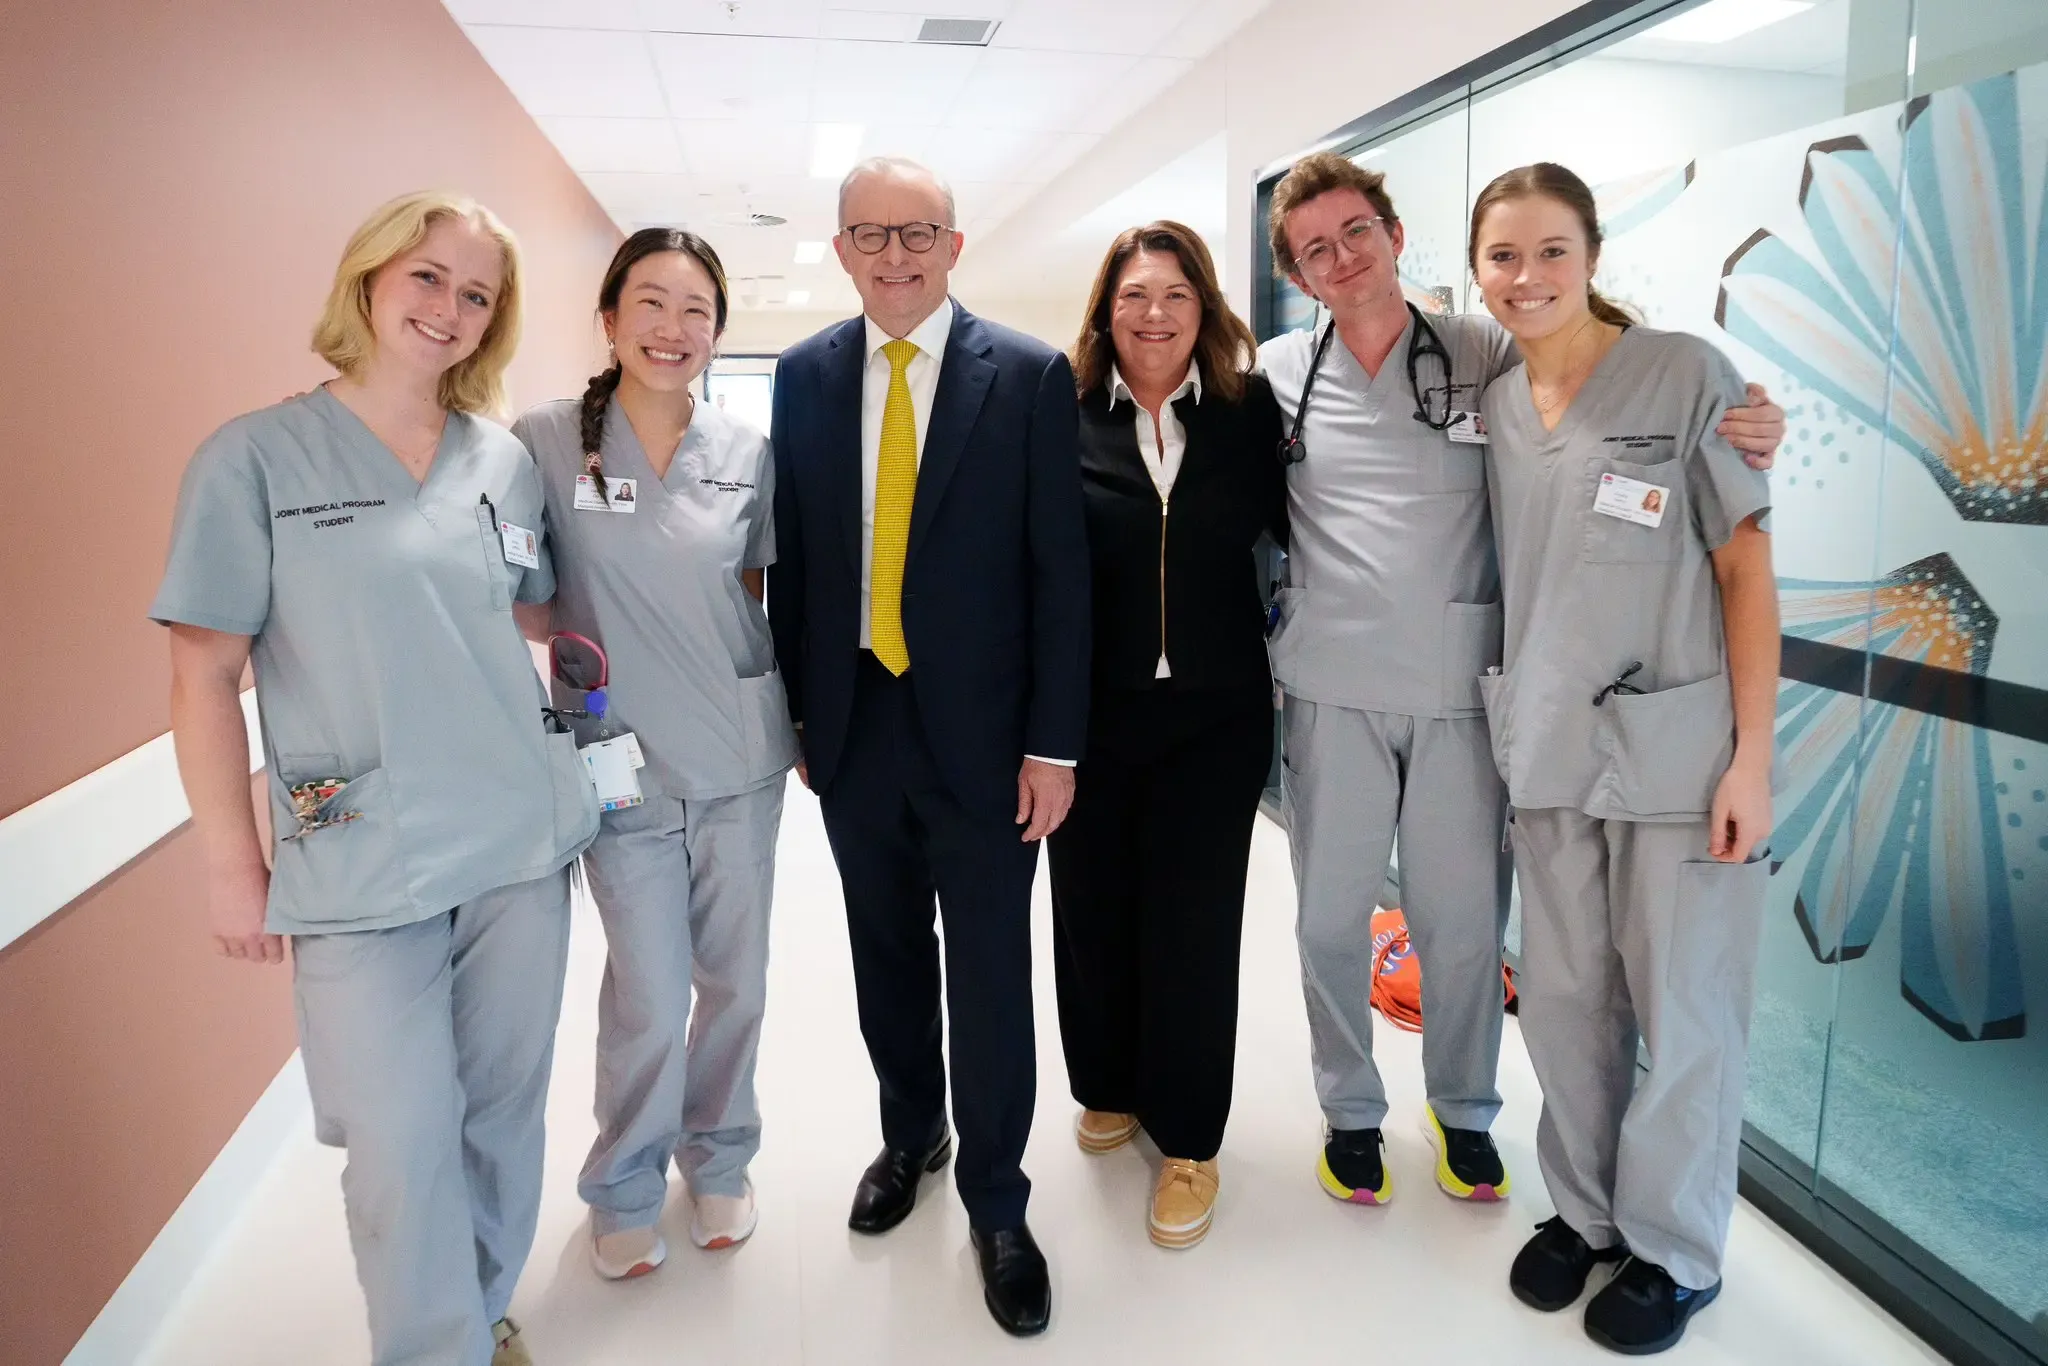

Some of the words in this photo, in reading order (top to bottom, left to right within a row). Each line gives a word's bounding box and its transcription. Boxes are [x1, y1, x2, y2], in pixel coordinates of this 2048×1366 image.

[274, 508, 301, 519] JOINT
[302, 502, 341, 515] MEDICAL
[342, 499, 386, 508] PROGRAM
[313, 516, 354, 529] STUDENT
